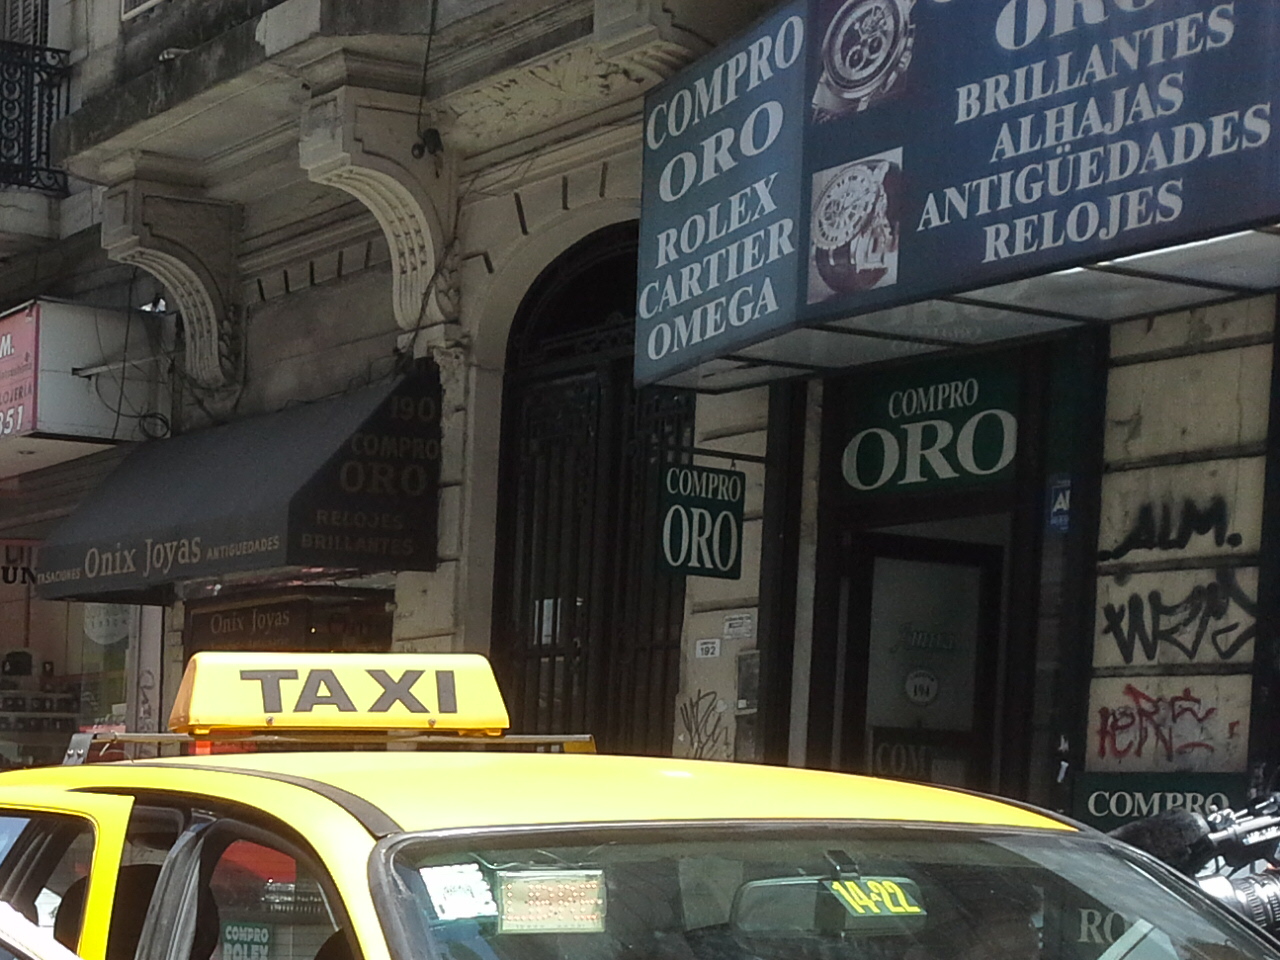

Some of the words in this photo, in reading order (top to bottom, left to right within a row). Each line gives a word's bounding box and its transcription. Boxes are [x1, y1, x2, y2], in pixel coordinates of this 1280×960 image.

[995, 0, 1157, 51] OR
[647, 14, 804, 151] COMPRO
[955, 7, 1236, 124] BRILLANTES
[990, 72, 1186, 162] ALHAJAS
[659, 100, 784, 202] ORO
[918, 102, 1272, 231] ANTIGÜEDADES
[655, 173, 778, 268] ROLEX
[983, 179, 1185, 263] RELOJES
[640, 218, 795, 320] CARTIER
[647, 277, 779, 360] OMEGA
[888, 378, 978, 419] COMPRO
[351, 433, 439, 460] COMPRO
[843, 409, 1017, 490] ORO
[340, 460, 427, 496] ORO
[666, 467, 741, 502] COMPRO
[300, 533, 414, 556] BRILLANTES
[316, 509, 405, 531] RELOJES
[662, 506, 739, 572] ORO
[84, 542, 137, 579] Onix
[144, 536, 202, 577] Joyas
[210, 611, 245, 635] Onix
[250, 608, 290, 635] Joyas
[240, 669, 458, 714] TAXI
[224, 925, 269, 943] COMPRO
